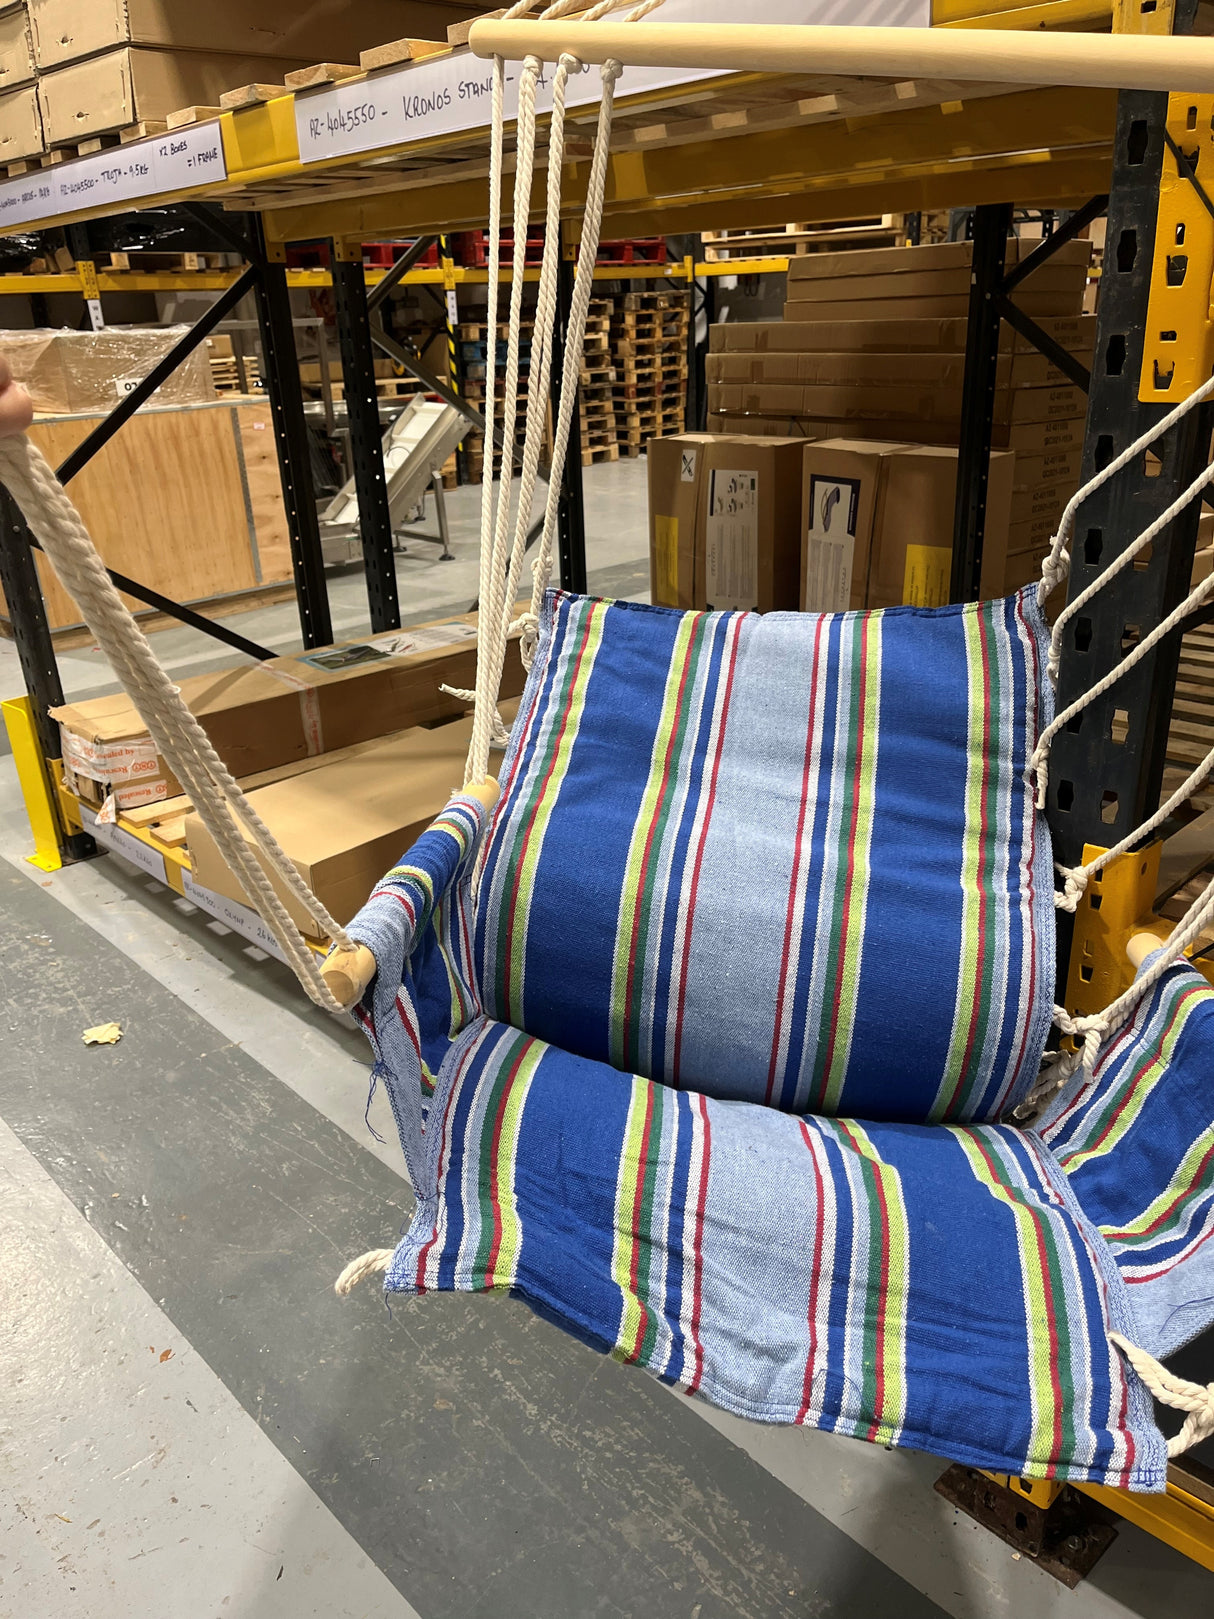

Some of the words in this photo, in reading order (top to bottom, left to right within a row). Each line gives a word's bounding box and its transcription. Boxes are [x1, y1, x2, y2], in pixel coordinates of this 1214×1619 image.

[309, 103, 376, 140] AZ-4045550
[402, 87, 451, 121] KRONOS
[197, 147, 218, 166] FRAME
[125, 748, 135, 756] by
